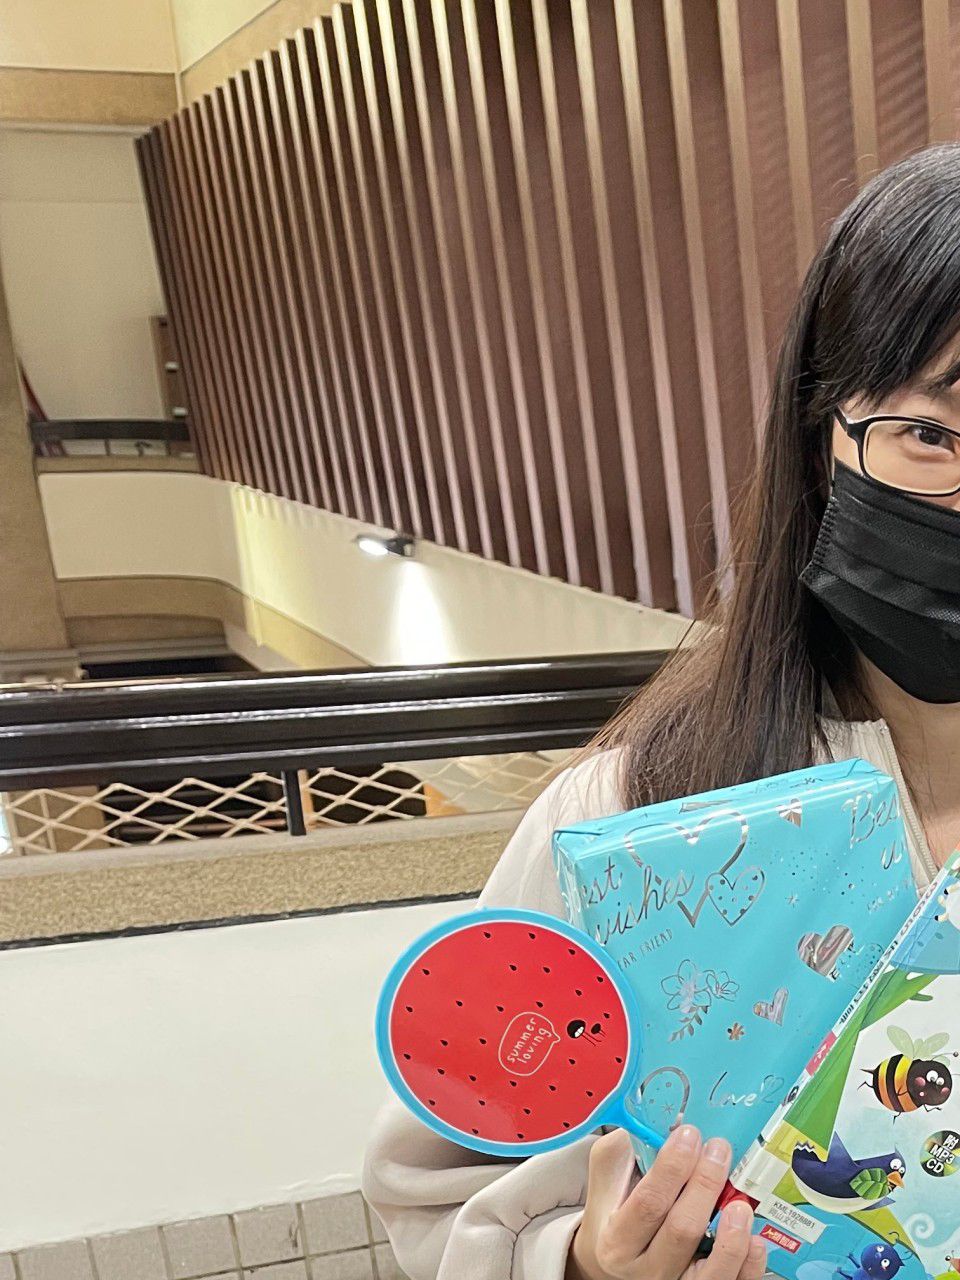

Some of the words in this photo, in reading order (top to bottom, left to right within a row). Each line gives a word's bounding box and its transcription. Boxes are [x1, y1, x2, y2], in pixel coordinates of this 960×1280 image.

[506, 1018, 537, 1064] summer
[517, 1027, 552, 1064] loving
[943, 1134, 959, 1150] 附
[929, 1144, 955, 1165] MP3
[926, 1158, 944, 1173] CD
